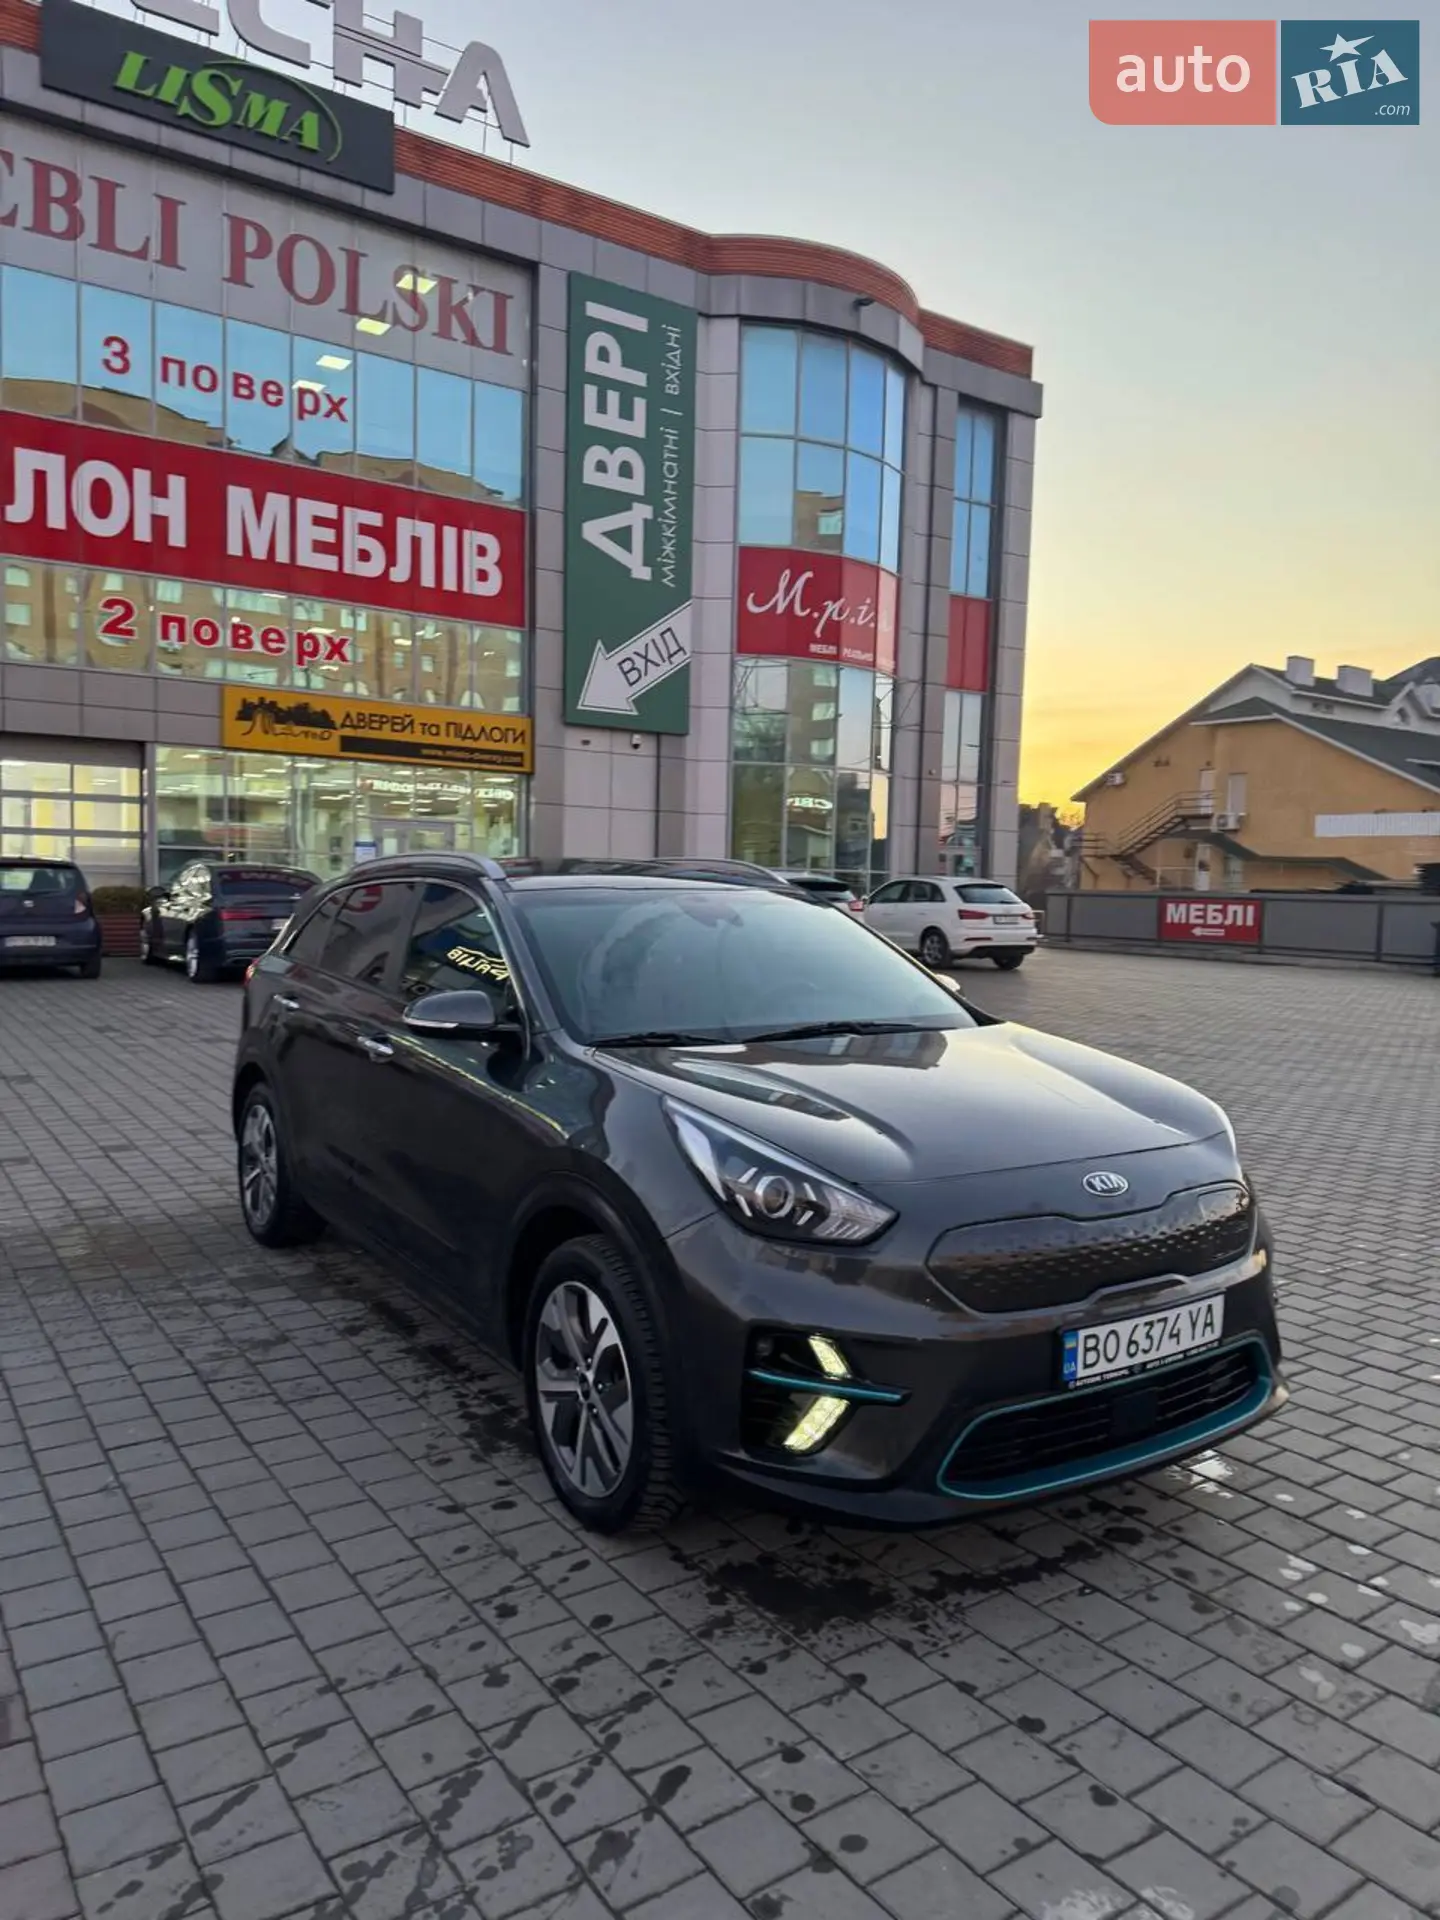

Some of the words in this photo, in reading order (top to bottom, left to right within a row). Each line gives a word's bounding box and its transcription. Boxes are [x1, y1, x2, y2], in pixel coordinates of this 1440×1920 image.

[113, 50, 322, 152] LISMA
[131, 0, 530, 147] СНА
[222, 212, 514, 356] POLSKI
[102, 335, 132, 376] 3
[161, 354, 349, 424] поверх
[581, 301, 653, 581] ДВЕРІ
[5, 446, 188, 549] ЛОН
[226, 484, 503, 599] МЕБЛІВ
[100, 597, 137, 639] 2
[159, 612, 353, 667] поверх
[616, 626, 686, 688] ВХІД
[340, 710, 415, 734] ДВЕРЕЙ
[419, 722, 441, 737] та
[445, 720, 527, 745] ПІДЛОГИ
[1166, 903, 1255, 927] МЕБЛІ
[1088, 1174, 1125, 1192] KIA
[1082, 1329, 1120, 1370] BO
[1126, 1313, 1181, 1358] 6374
[1188, 1303, 1214, 1341] YA
